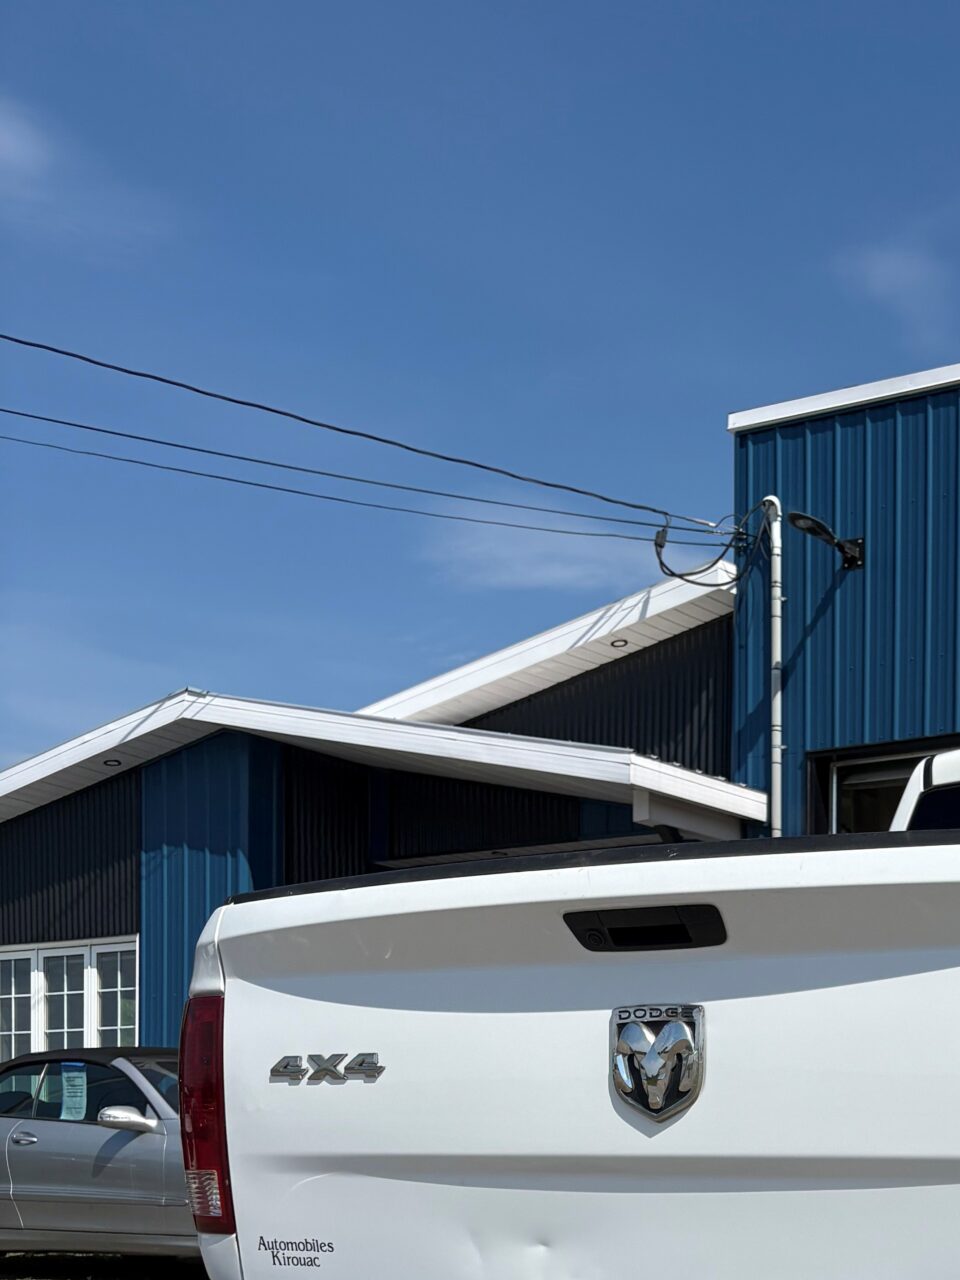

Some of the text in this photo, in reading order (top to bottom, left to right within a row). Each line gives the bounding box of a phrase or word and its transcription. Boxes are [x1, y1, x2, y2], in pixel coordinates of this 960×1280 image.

[618, 1007, 694, 1020] DODGE
[270, 1053, 386, 1081] 4X4
[258, 1235, 335, 1253] Automobiles
[271, 1251, 321, 1268] Kirouac
